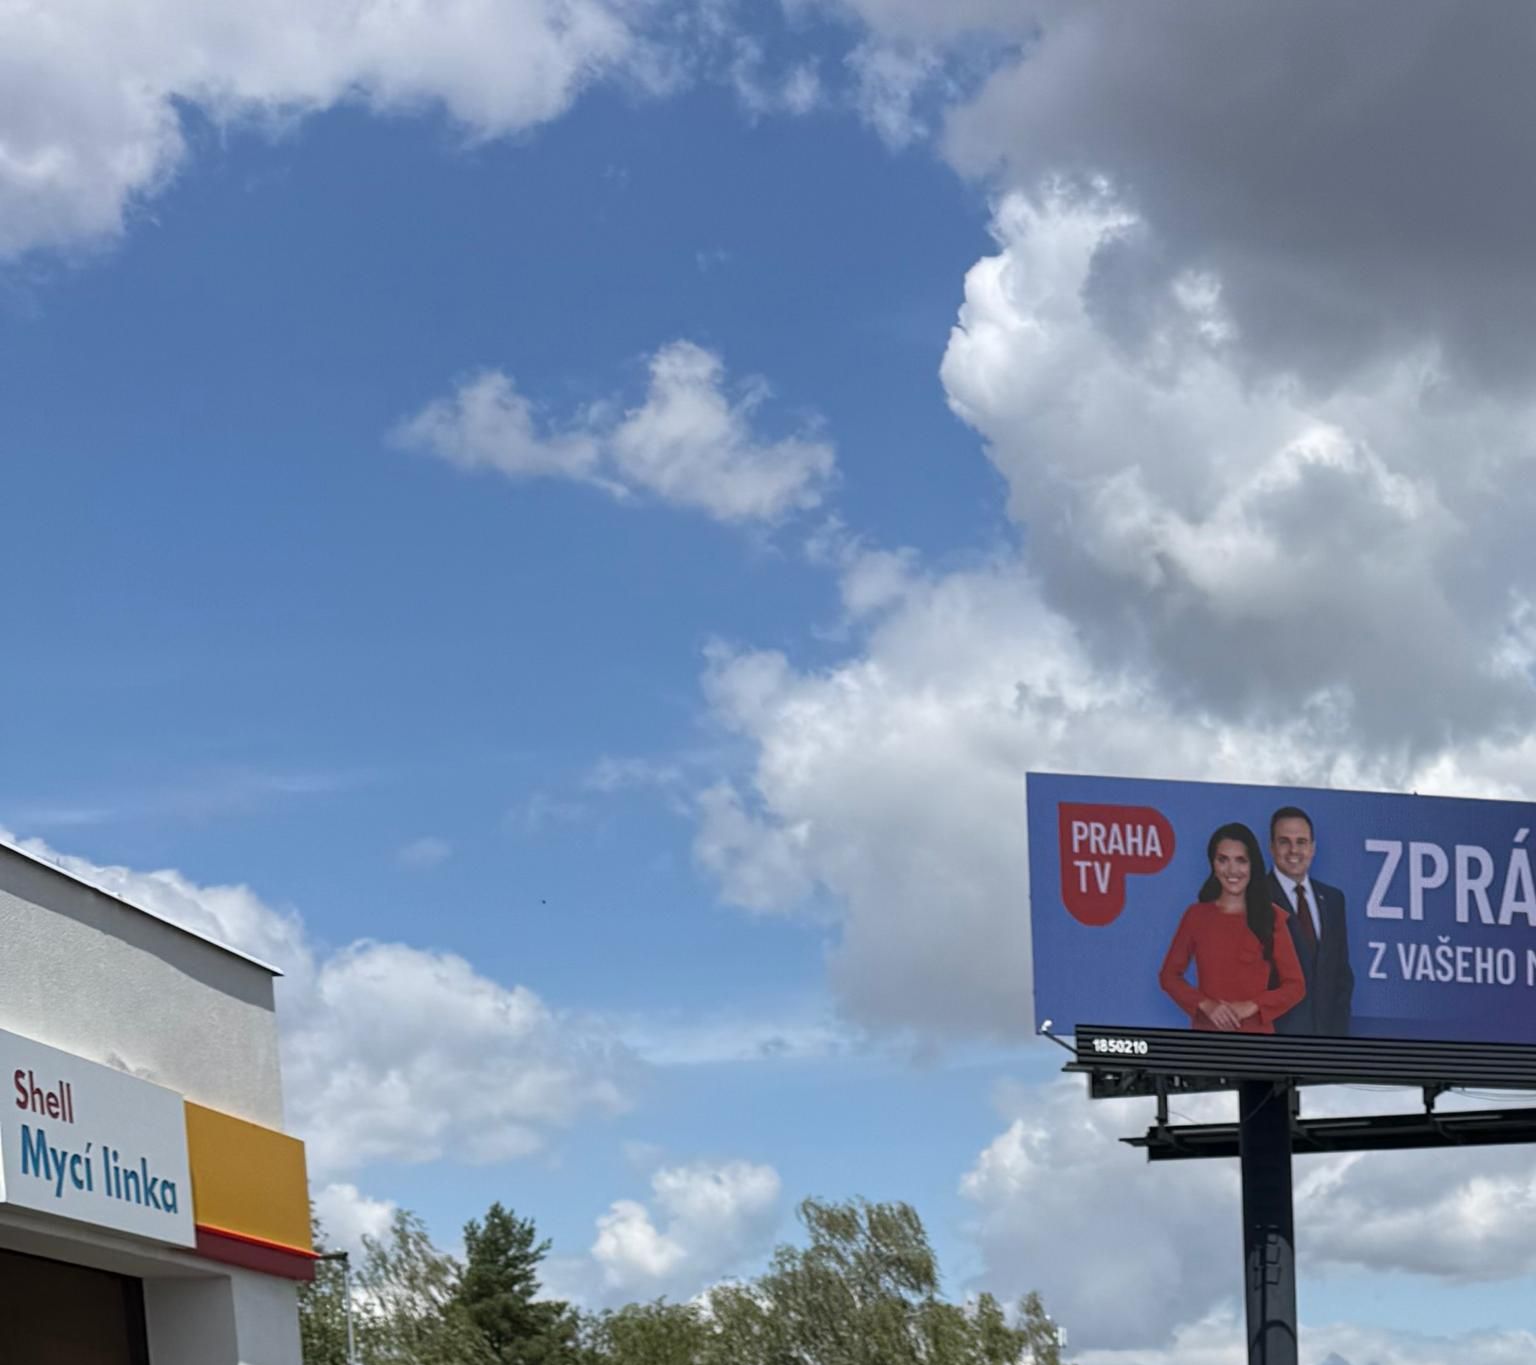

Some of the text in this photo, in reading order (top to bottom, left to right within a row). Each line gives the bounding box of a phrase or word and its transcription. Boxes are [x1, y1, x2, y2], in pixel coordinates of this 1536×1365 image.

[1072, 820, 1163, 858] PRAHA
[1073, 859, 1111, 895] TV
[1367, 941, 1388, 979] Z
[1398, 936, 1516, 984] VAŠEHO
[1092, 1038, 1149, 1055] 1850210
[14, 1069, 74, 1124] Shell
[21, 1123, 178, 1214] Mycí linka
